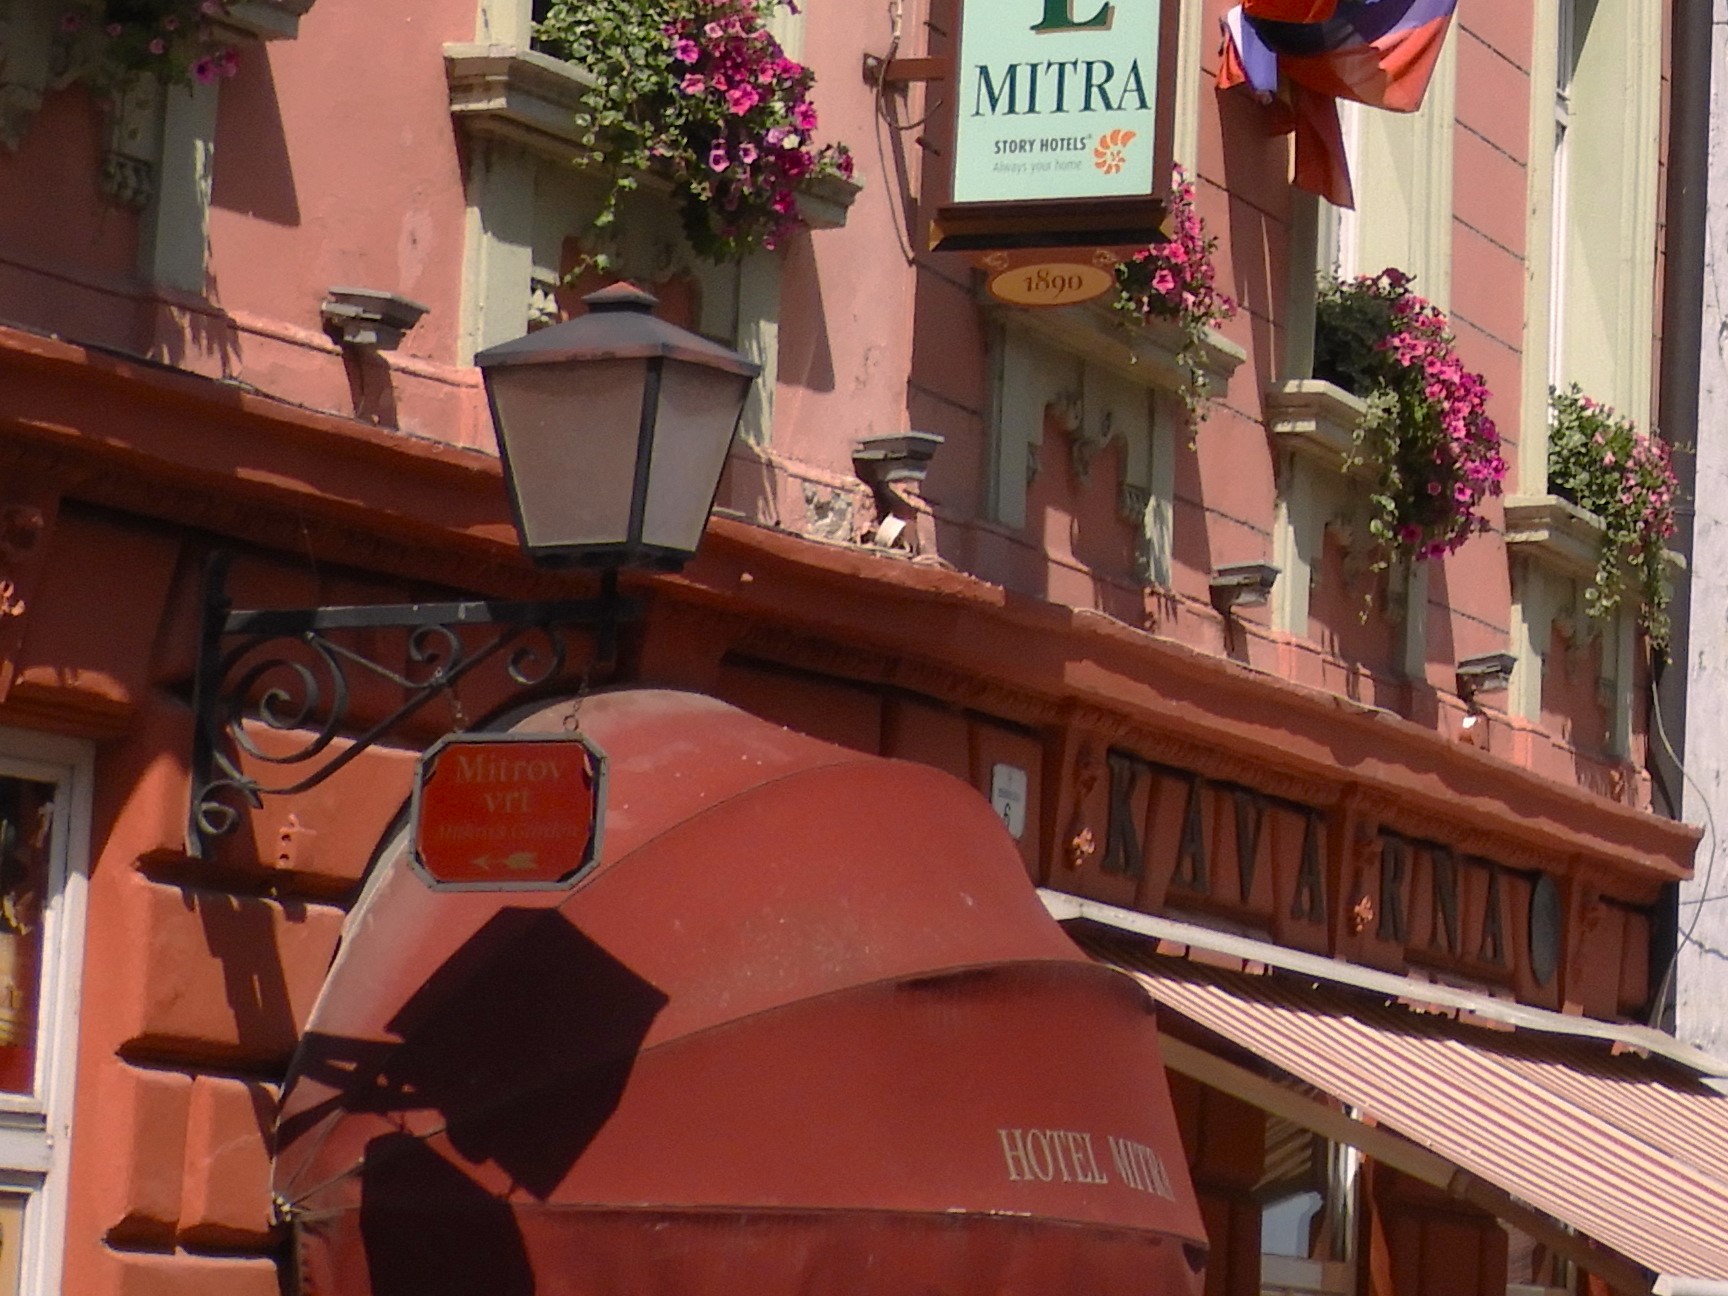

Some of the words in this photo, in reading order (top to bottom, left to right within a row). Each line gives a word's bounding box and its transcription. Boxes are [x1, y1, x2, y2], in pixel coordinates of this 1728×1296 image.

[970, 58, 1152, 117] MITRA
[994, 138, 1036, 155] STORY
[992, 161, 1027, 175] Always
[1031, 161, 1051, 174] your
[1054, 159, 1083, 172] home
[1023, 268, 1083, 302] 1890
[455, 752, 565, 784] Mitrov
[483, 788, 531, 814] vrt
[997, 1128, 1109, 1184] HOTEL
